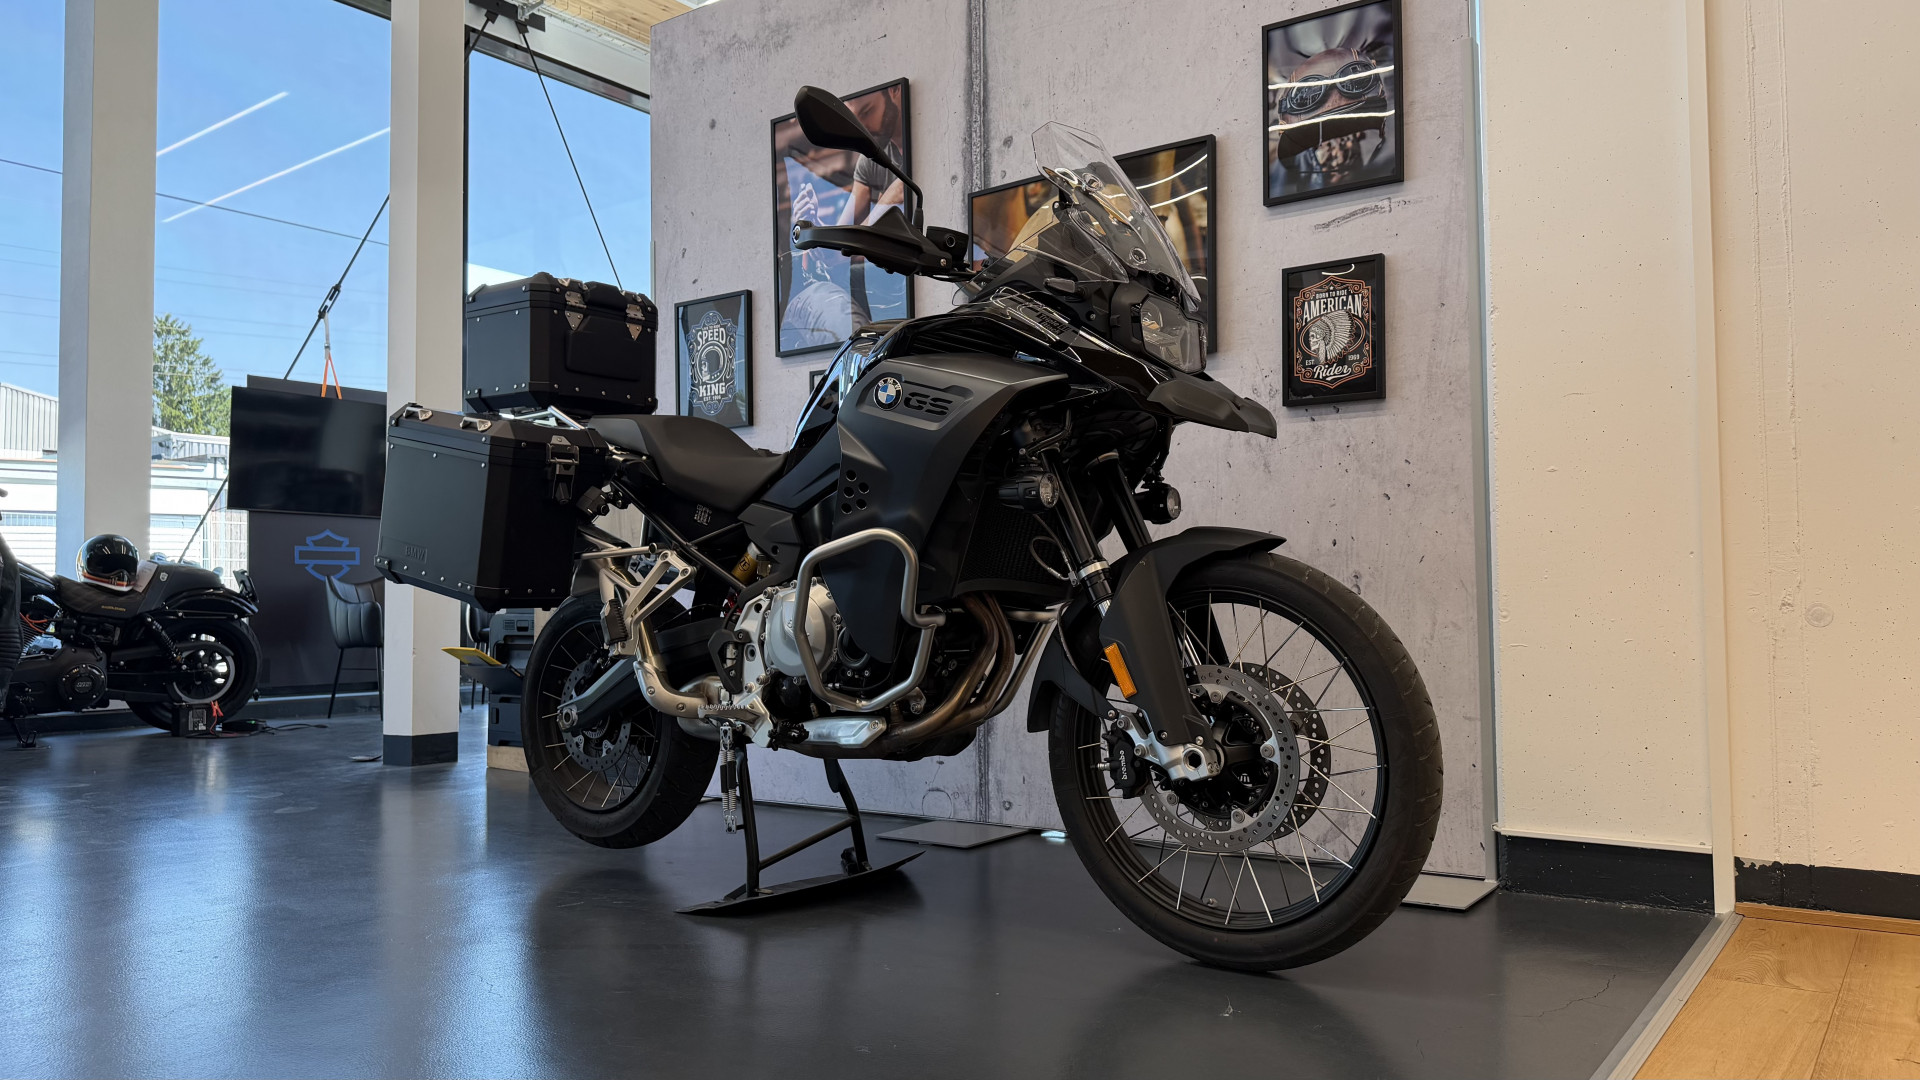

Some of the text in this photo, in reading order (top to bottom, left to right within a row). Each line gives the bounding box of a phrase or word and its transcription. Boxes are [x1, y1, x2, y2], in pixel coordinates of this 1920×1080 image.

[1302, 293, 1363, 326] AMERICAN
[697, 327, 726, 350] SPEED
[1313, 362, 1352, 381] Rider
[699, 383, 725, 397] KING
[904, 392, 953, 415] GS
[406, 545, 427, 563] BMW
[1119, 750, 1128, 779] brembo
